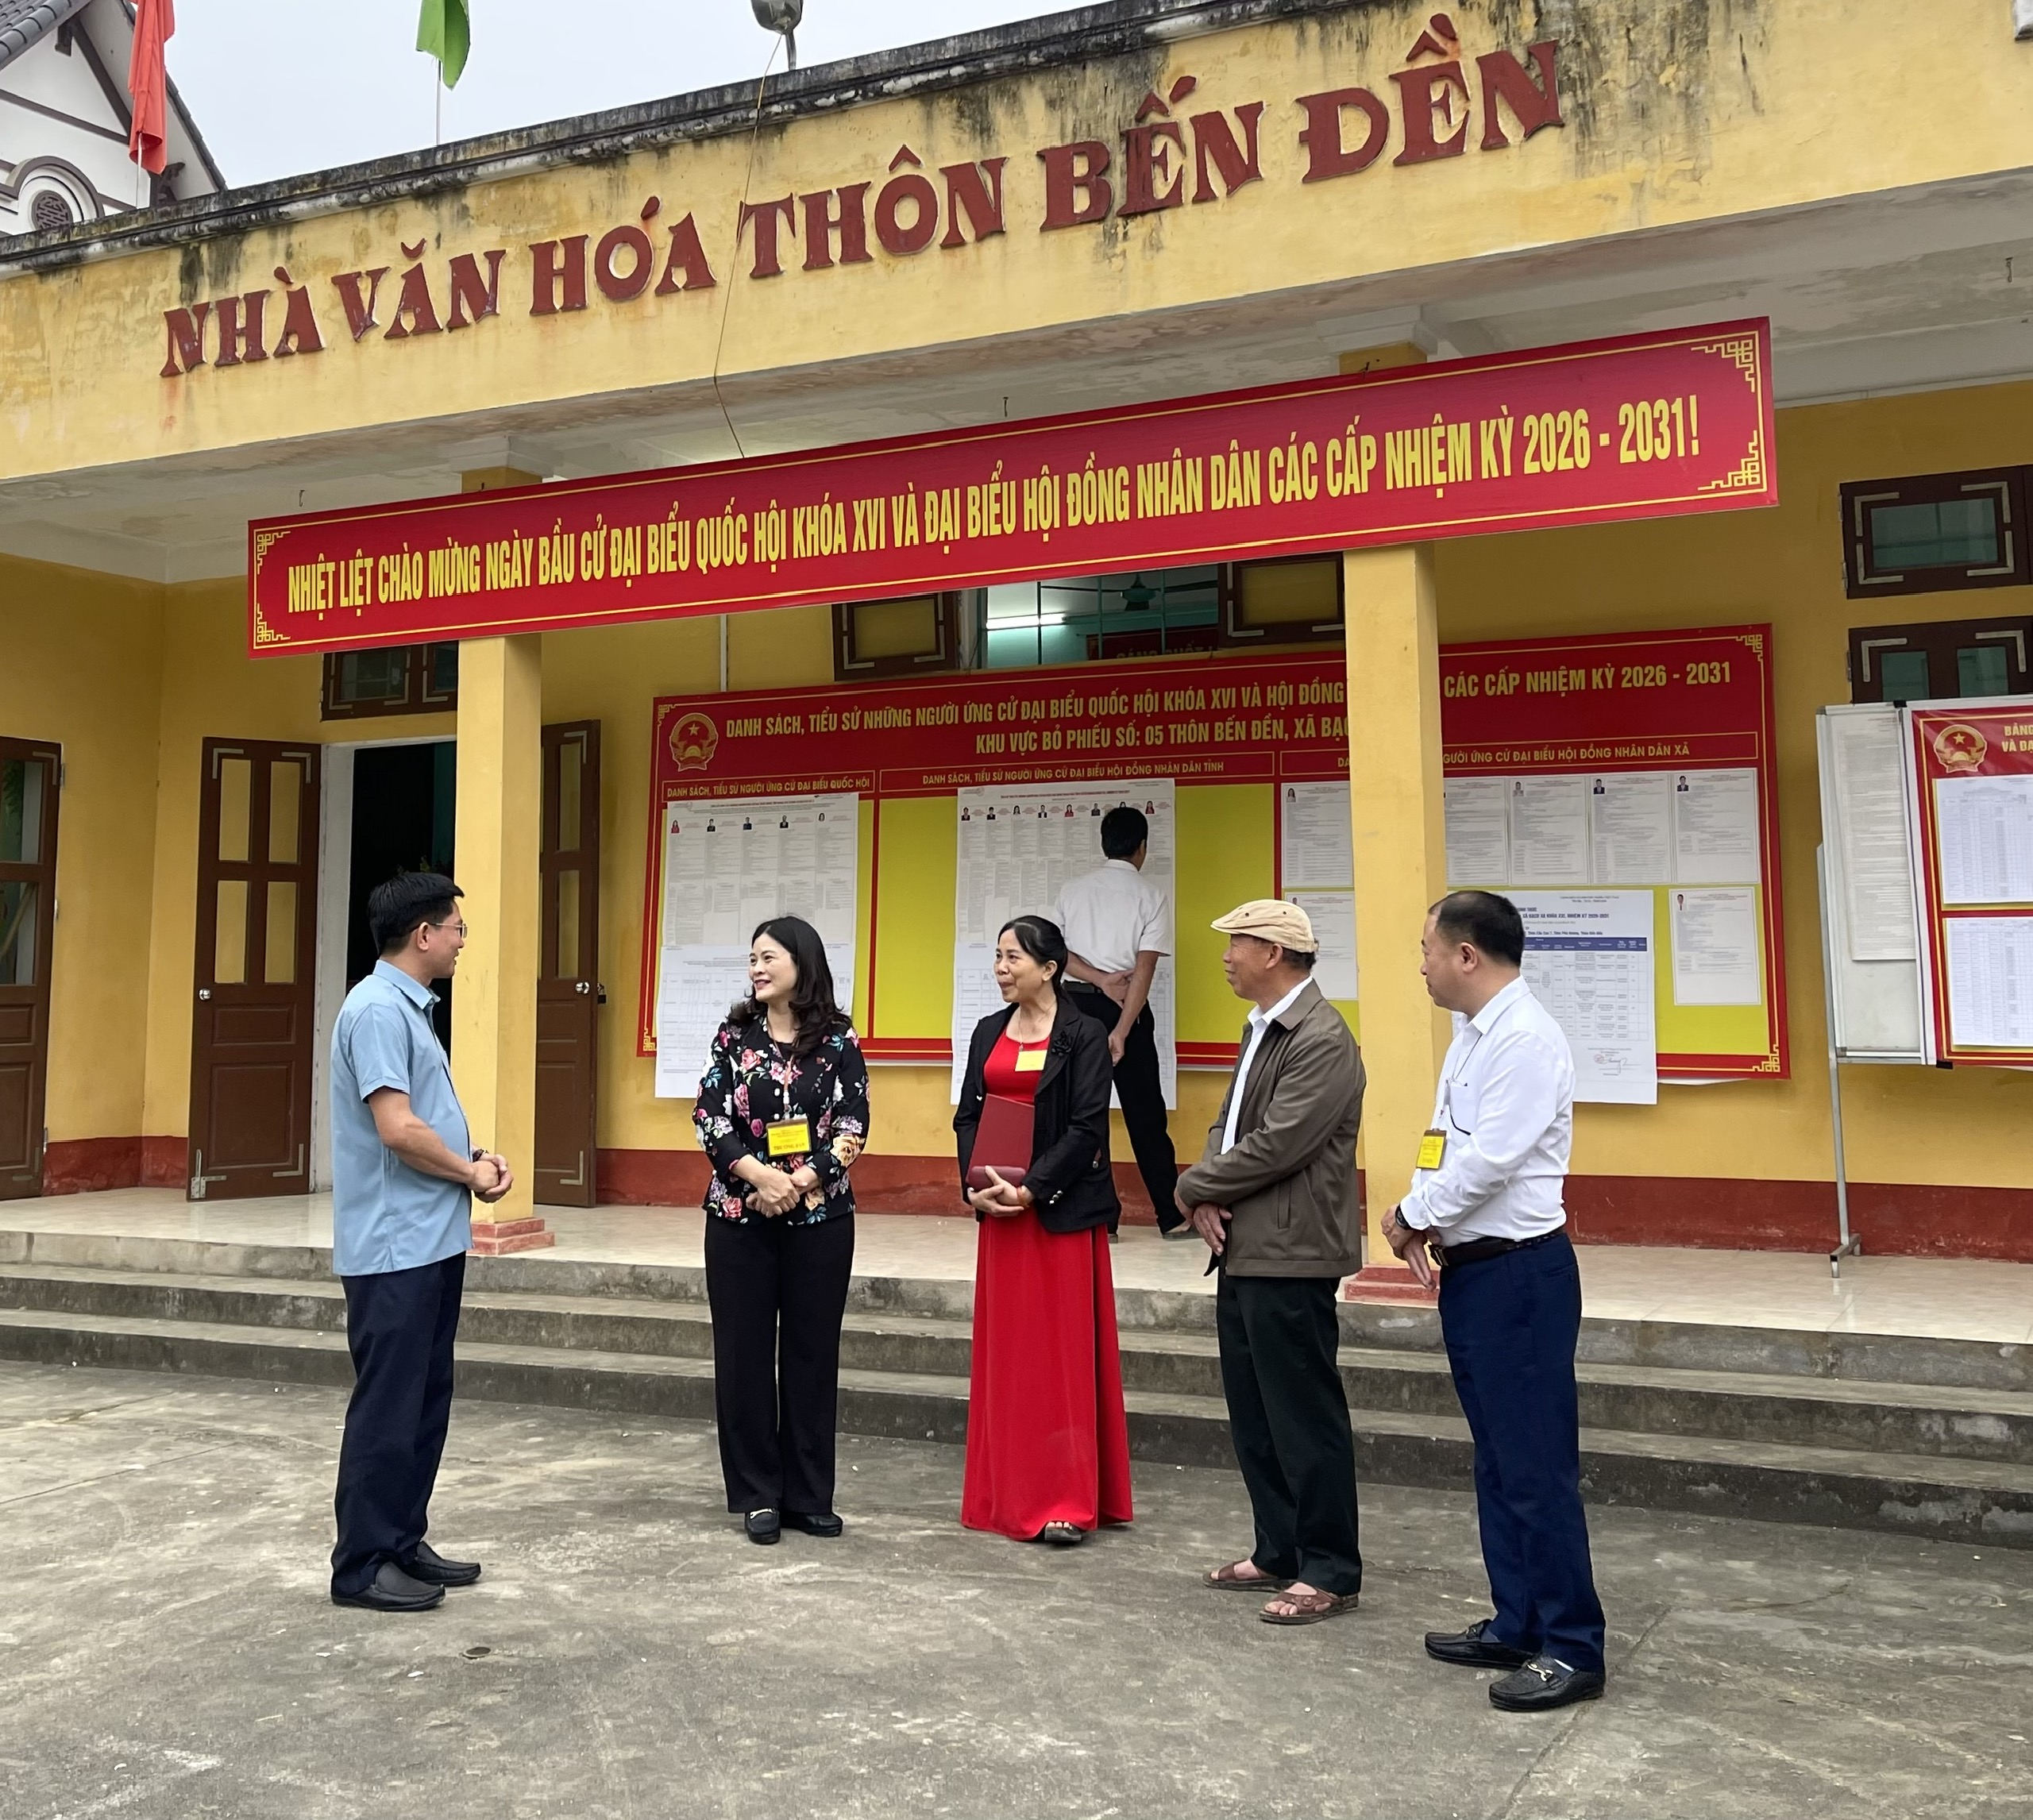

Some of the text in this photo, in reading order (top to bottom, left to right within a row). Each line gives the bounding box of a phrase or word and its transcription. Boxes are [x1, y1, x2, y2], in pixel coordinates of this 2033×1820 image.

[160, 13, 1565, 377] NHÀ VĂN HÓA THÔN BẾN ĐỀN
[288, 395, 1699, 620] NHIỆT LIỆT CHÀO MỪNG NGÀY BẦU CỬ ĐẠI BIỂU QUỐC HỘI KHÓA XVI VÀ ĐẠI BIỂU HỘI ĐỒNG NHÂN DÂN CÁC CẤP NHIỆM KỲ 2026 - 2031!
[727, 718, 762, 738] DANH
[766, 713, 804, 735] SÁCH,
[808, 706, 837, 732] TIỂU
[842, 705, 862, 731] SỬ
[863, 706, 911, 729] NHỮNG
[916, 701, 959, 726] NGƯỜI
[963, 700, 993, 723] ỨNG
[997, 696, 1018, 721] CỬ
[1021, 700, 1045, 723] ĐẠI
[1050, 689, 1083, 718] BIỂU
[1089, 688, 1128, 718] QUỐC
[1133, 688, 1159, 717] HỘI
[1164, 686, 1206, 711] KHÓA
[1211, 688, 1236, 709] XVI
[1241, 682, 1262, 708] VÀ
[1267, 681, 1293, 710] HỘI
[1299, 677, 1344, 704] ĐỒNG
[1444, 671, 1479, 697] CÁC
[1485, 665, 1520, 696] CẤP
[1526, 665, 1585, 697] NHIỆM
[1591, 663, 1614, 689] KỲ
[1621, 665, 1666, 688] 2026
[1686, 661, 1730, 684] 2031
[976, 734, 1005, 754] KHU
[1009, 731, 1037, 756] VỰC
[1042, 724, 1062, 750] BỎ
[1067, 722, 1110, 749] PHIẾU
[1116, 719, 1140, 747] SỐ:
[1145, 725, 1163, 746] 05
[1168, 719, 1209, 744] THÔN
[1214, 715, 1246, 742] BẾN
[1251, 713, 1288, 742] ĐỀN,
[1294, 713, 1316, 738] XÃ
[1443, 750, 1468, 763] GƯỜI
[1471, 750, 1492, 762] ỨNG
[1495, 748, 1510, 762] CỬ
[1513, 750, 1530, 765] ĐẠI
[1533, 744, 1555, 761] BIỂU
[1558, 746, 1576, 762] HỘI
[1614, 744, 1645, 758] NHÂN
[1674, 742, 1690, 755] XÃ
